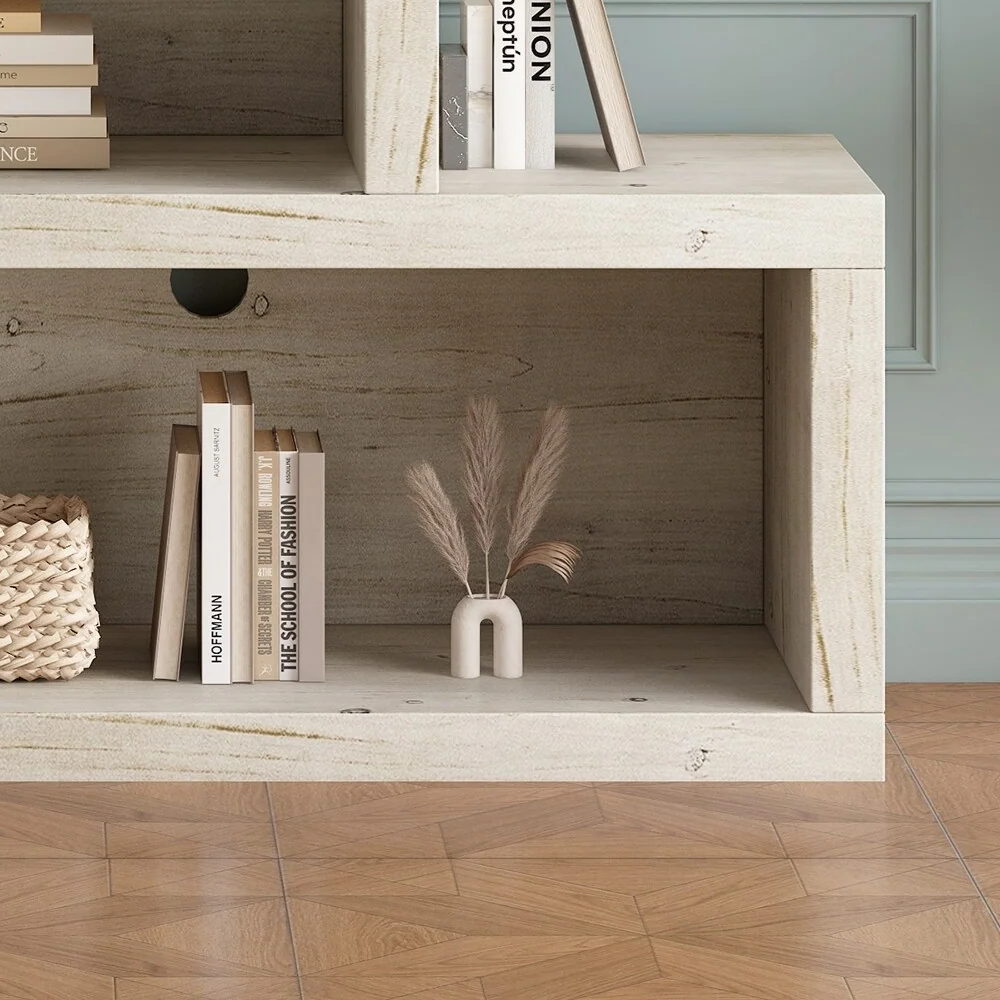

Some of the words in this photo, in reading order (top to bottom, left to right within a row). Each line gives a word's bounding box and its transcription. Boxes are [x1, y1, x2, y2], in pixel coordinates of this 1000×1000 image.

[258, 455, 272, 471] J.K.
[258, 473, 273, 507] ROWLING
[257, 509, 273, 535] HARRY
[280, 495, 297, 557] FASHION
[257, 536, 273, 565] POTTER
[280, 560, 298, 579] OF
[257, 579, 273, 615] CHAMBER
[280, 582, 298, 641] SCHOOL
[210, 595, 223, 663] HOFFMANN
[257, 623, 273, 655] SECRETS
[280, 643, 297, 673] THE
